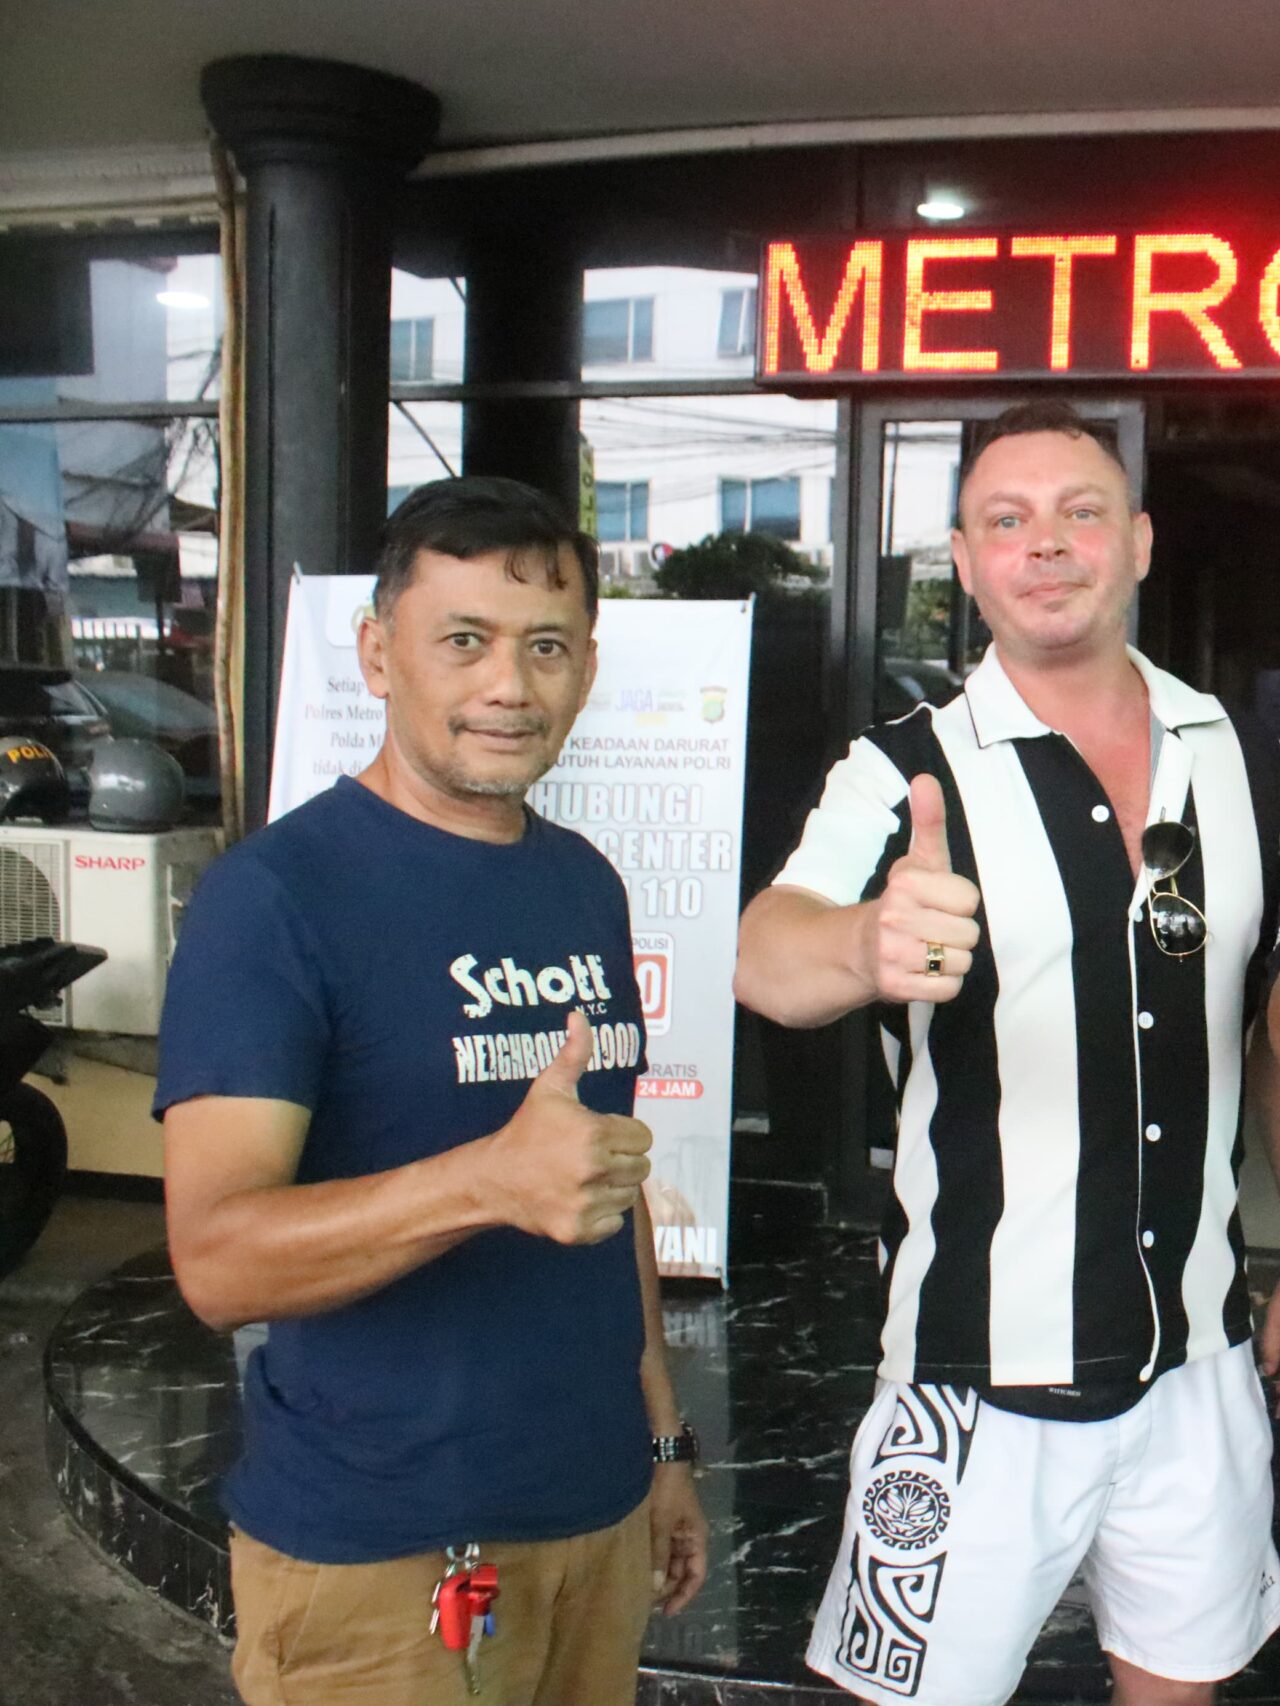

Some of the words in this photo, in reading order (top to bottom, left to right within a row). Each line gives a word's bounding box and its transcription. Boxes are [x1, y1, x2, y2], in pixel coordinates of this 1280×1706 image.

[346, 705, 383, 720] Metro
[569, 737, 650, 751] KEADAAN
[654, 738, 729, 752] DARURAT
[604, 756, 680, 769] LAYANAN
[683, 757, 732, 770] POLRI
[534, 781, 703, 825] HUBUNGI
[596, 827, 733, 872] CENTER
[74, 854, 146, 871] SHARP
[641, 876, 704, 919] 110
[449, 953, 612, 1019] Schott
[452, 1022, 640, 1084] NEIGHBOUHOOD
[648, 1063, 698, 1078] RATIS
[639, 1081, 657, 1096] 24
[661, 1082, 696, 1097] JAM
